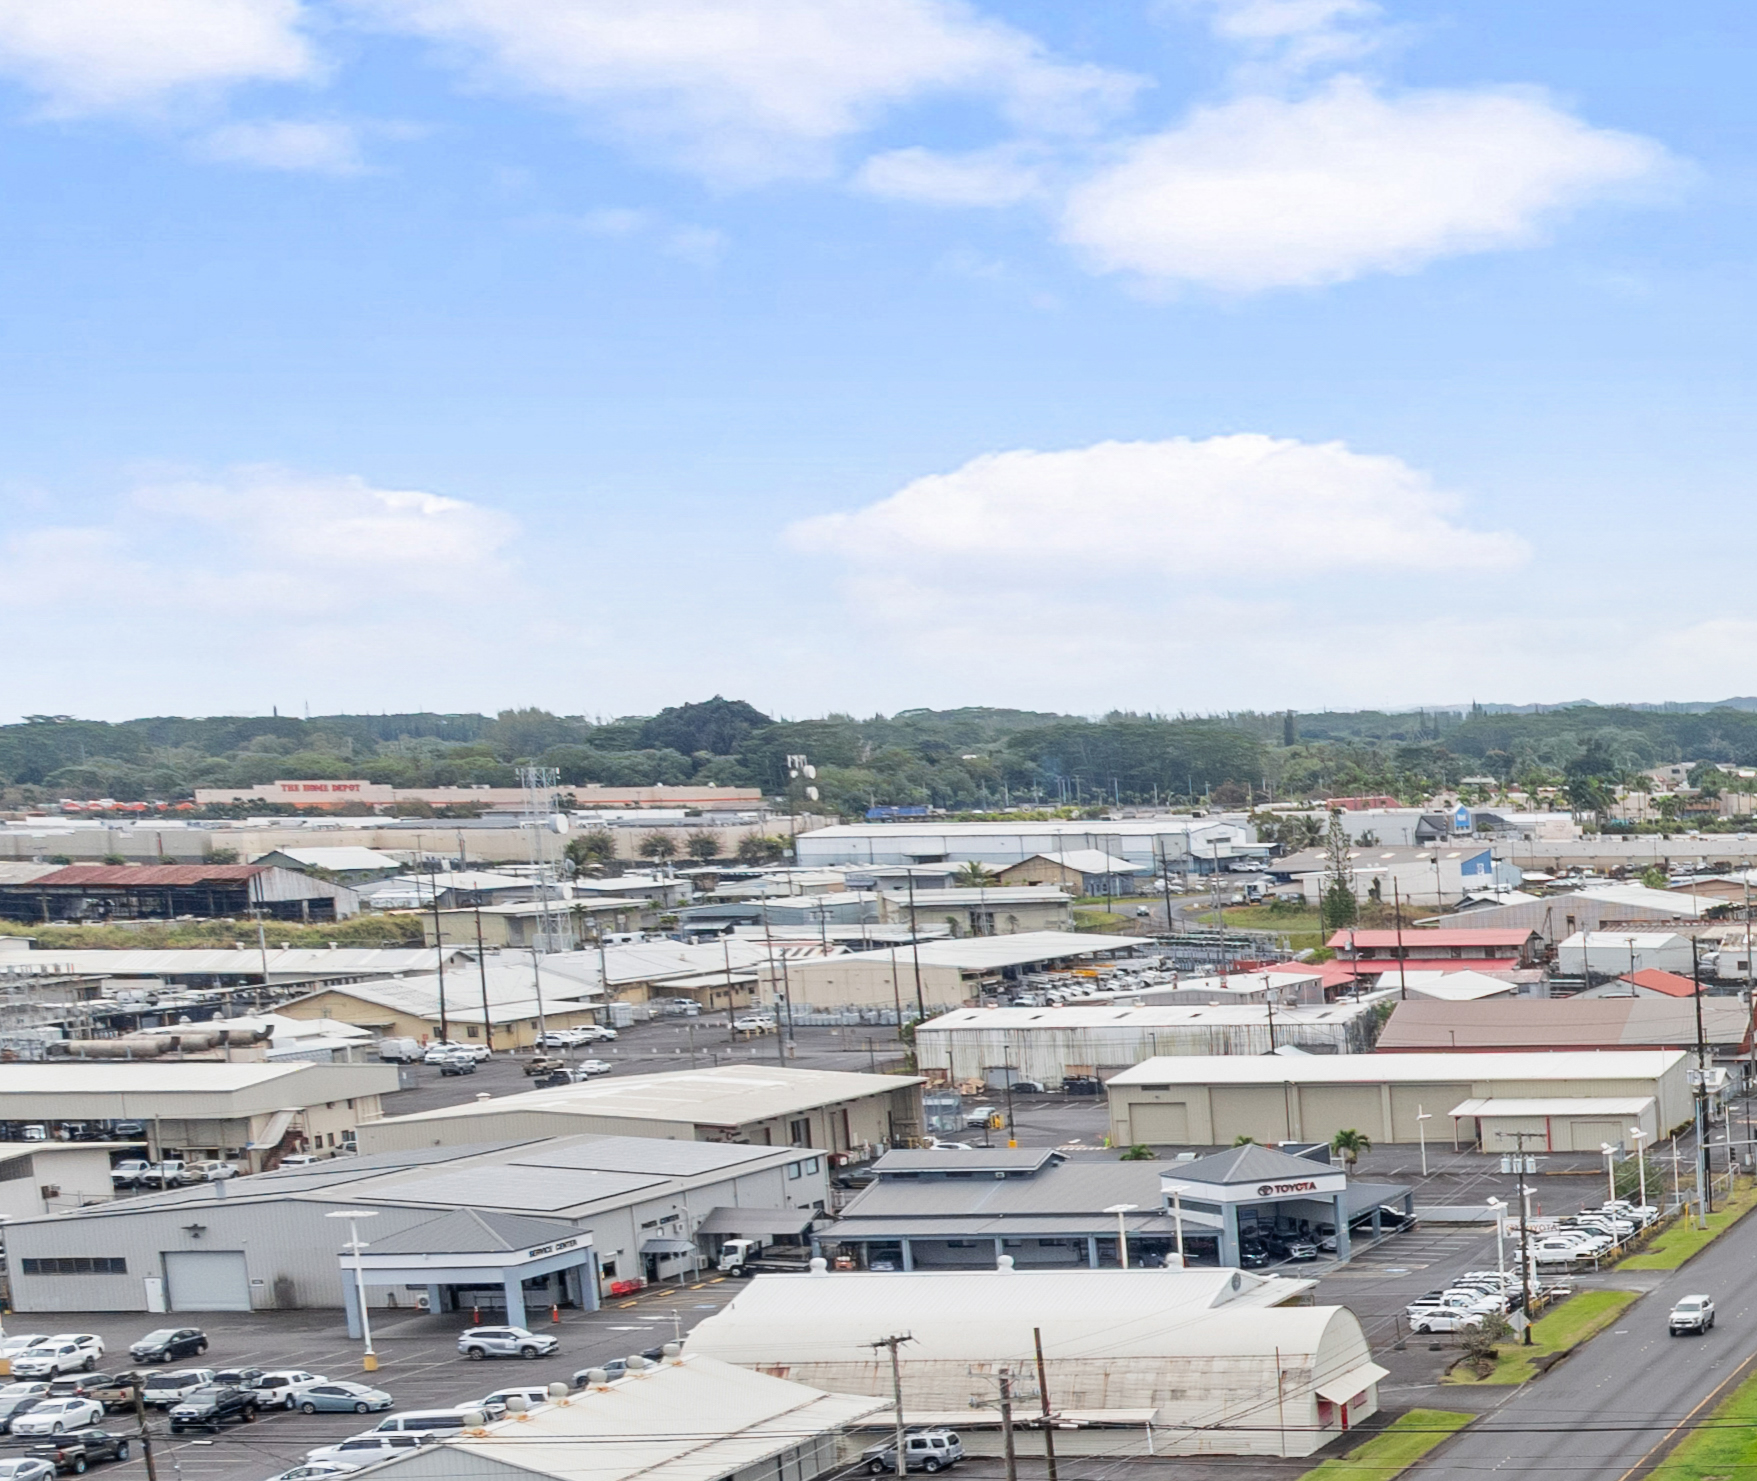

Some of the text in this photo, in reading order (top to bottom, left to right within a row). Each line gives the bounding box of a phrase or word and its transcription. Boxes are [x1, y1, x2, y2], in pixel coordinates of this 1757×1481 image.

[281, 784, 361, 792] THE HOME DEPOT
[1275, 1181, 1317, 1194] TOYOTA
[529, 1239, 578, 1258] SERVICE CENTER
